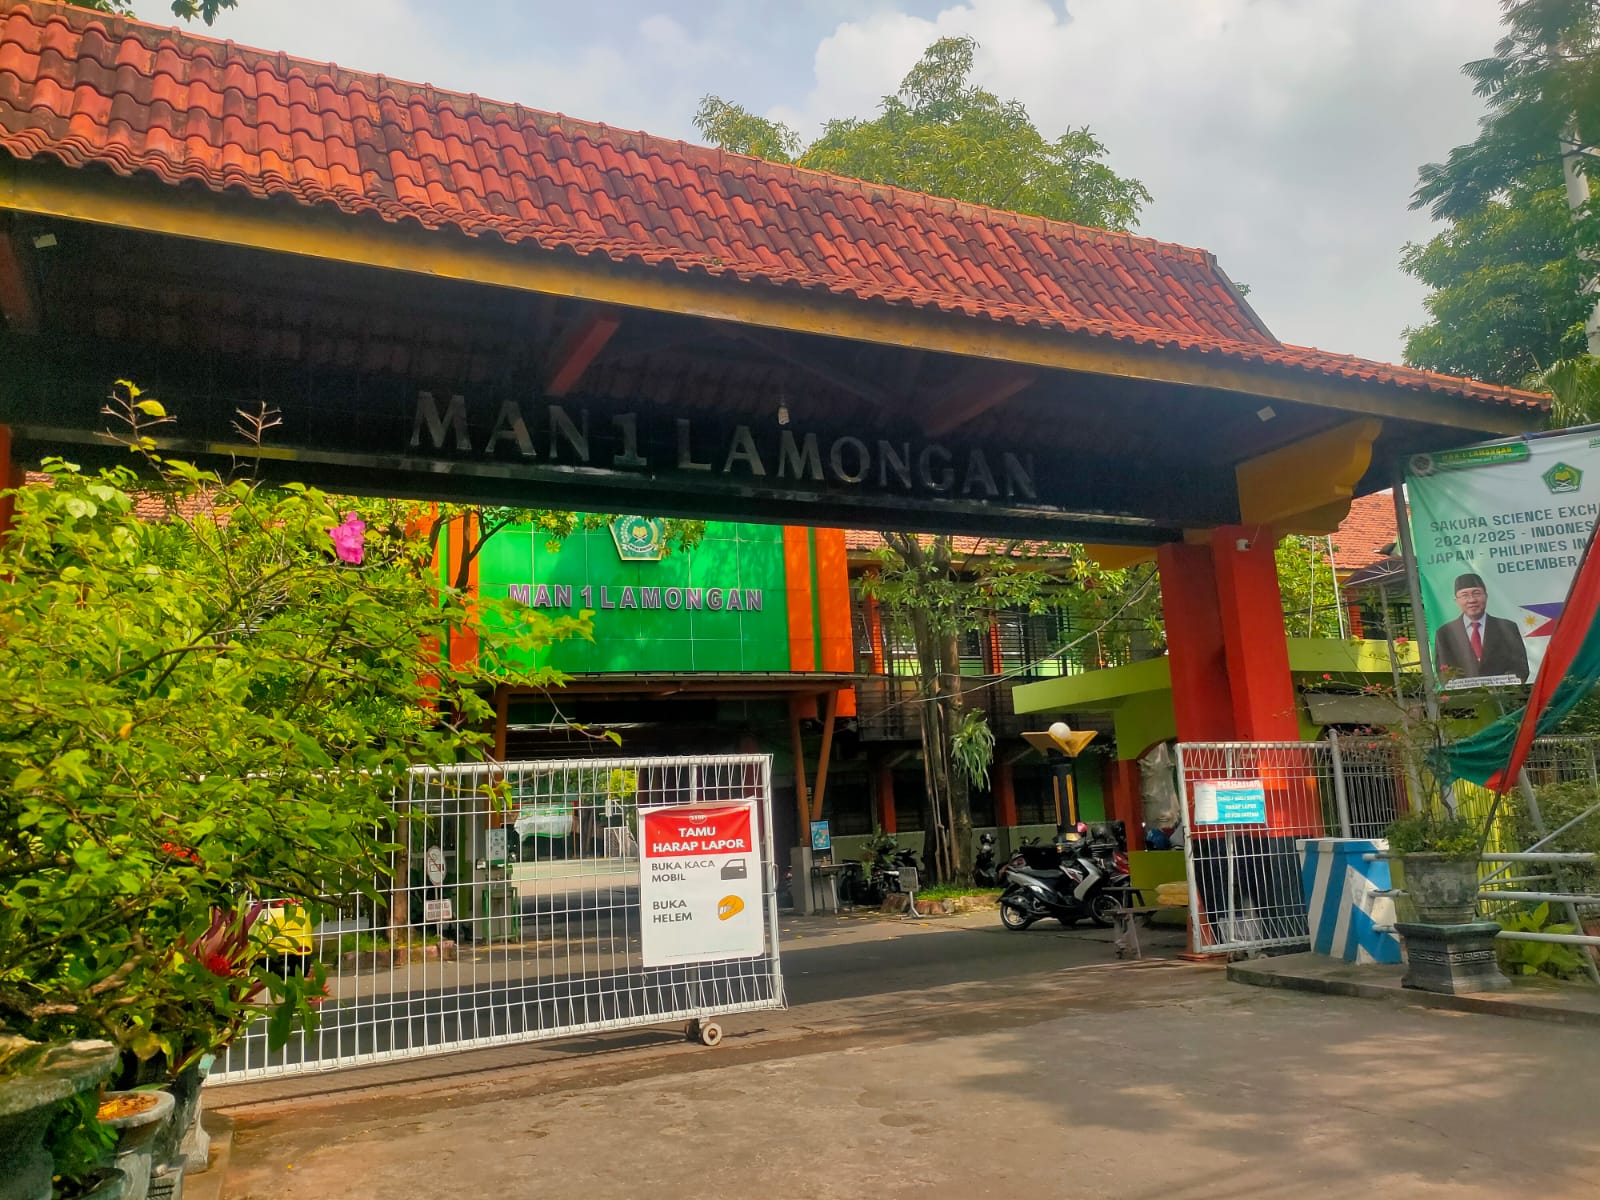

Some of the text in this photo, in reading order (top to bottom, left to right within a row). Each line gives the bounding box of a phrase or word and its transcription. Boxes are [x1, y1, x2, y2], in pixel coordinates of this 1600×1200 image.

[409, 389, 1039, 500] MAN 1 LAMONGAN
[1430, 516, 1488, 533] SAKURA
[1493, 509, 1553, 526] SCIENCE
[1434, 529, 1516, 548] 2024/2025
[1426, 549, 1475, 565] JAPAN
[1489, 540, 1568, 558] PHILIPINES
[1497, 555, 1578, 574] DECEMBER
[508, 583, 764, 612] MAN 1 LAMONGAN
[678, 826, 716, 838] TAMU
[653, 838, 745, 853] HARAP LAPOR
[651, 859, 716, 871] BUKA KACA
[651, 872, 686, 883] MOBIL
[653, 899, 687, 910] BUKA
[653, 911, 693, 924] HELEM
